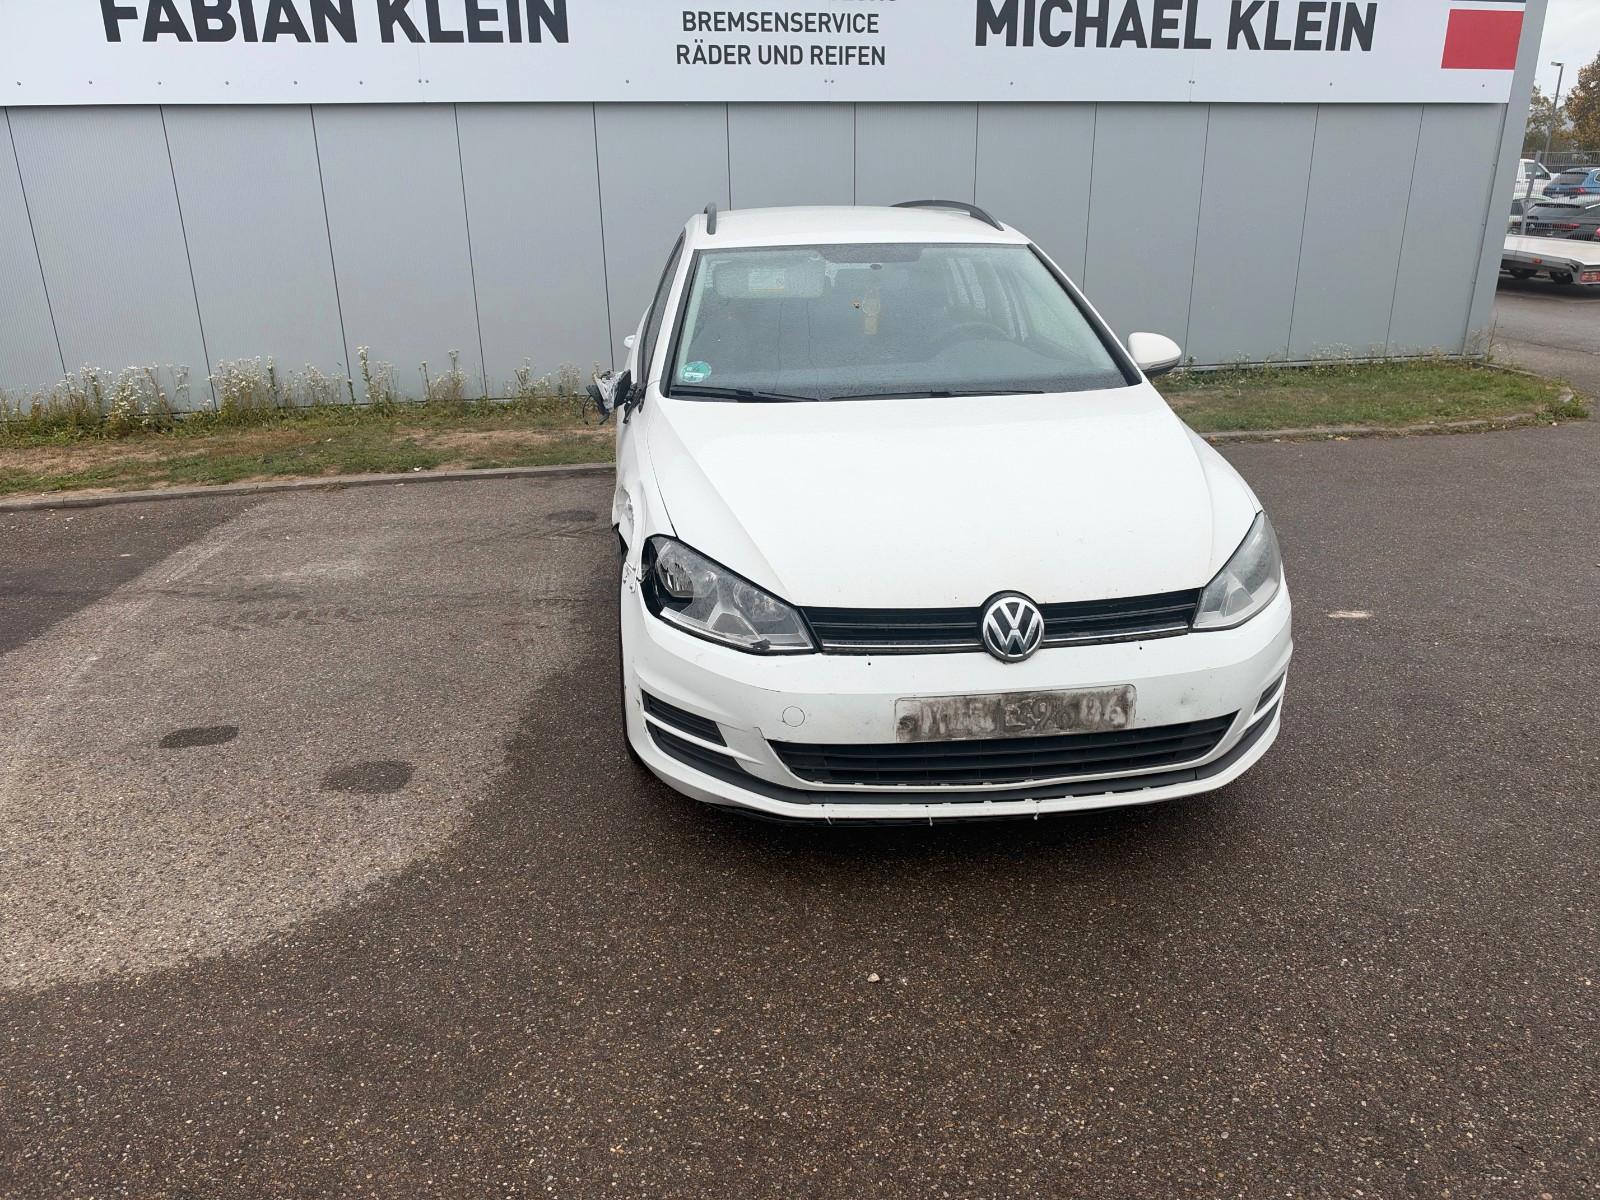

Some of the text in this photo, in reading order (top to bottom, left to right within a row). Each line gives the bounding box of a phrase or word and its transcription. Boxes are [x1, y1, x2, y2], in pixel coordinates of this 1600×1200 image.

[100, 0, 569, 44] FABIAN KLEIN
[682, 11, 879, 33] BREMSENSERVICE
[975, 0, 1378, 52] MICHAEL KLEIN
[676, 39, 886, 65] RÄDER UND REIFEN
[983, 597, 1042, 656] VW
